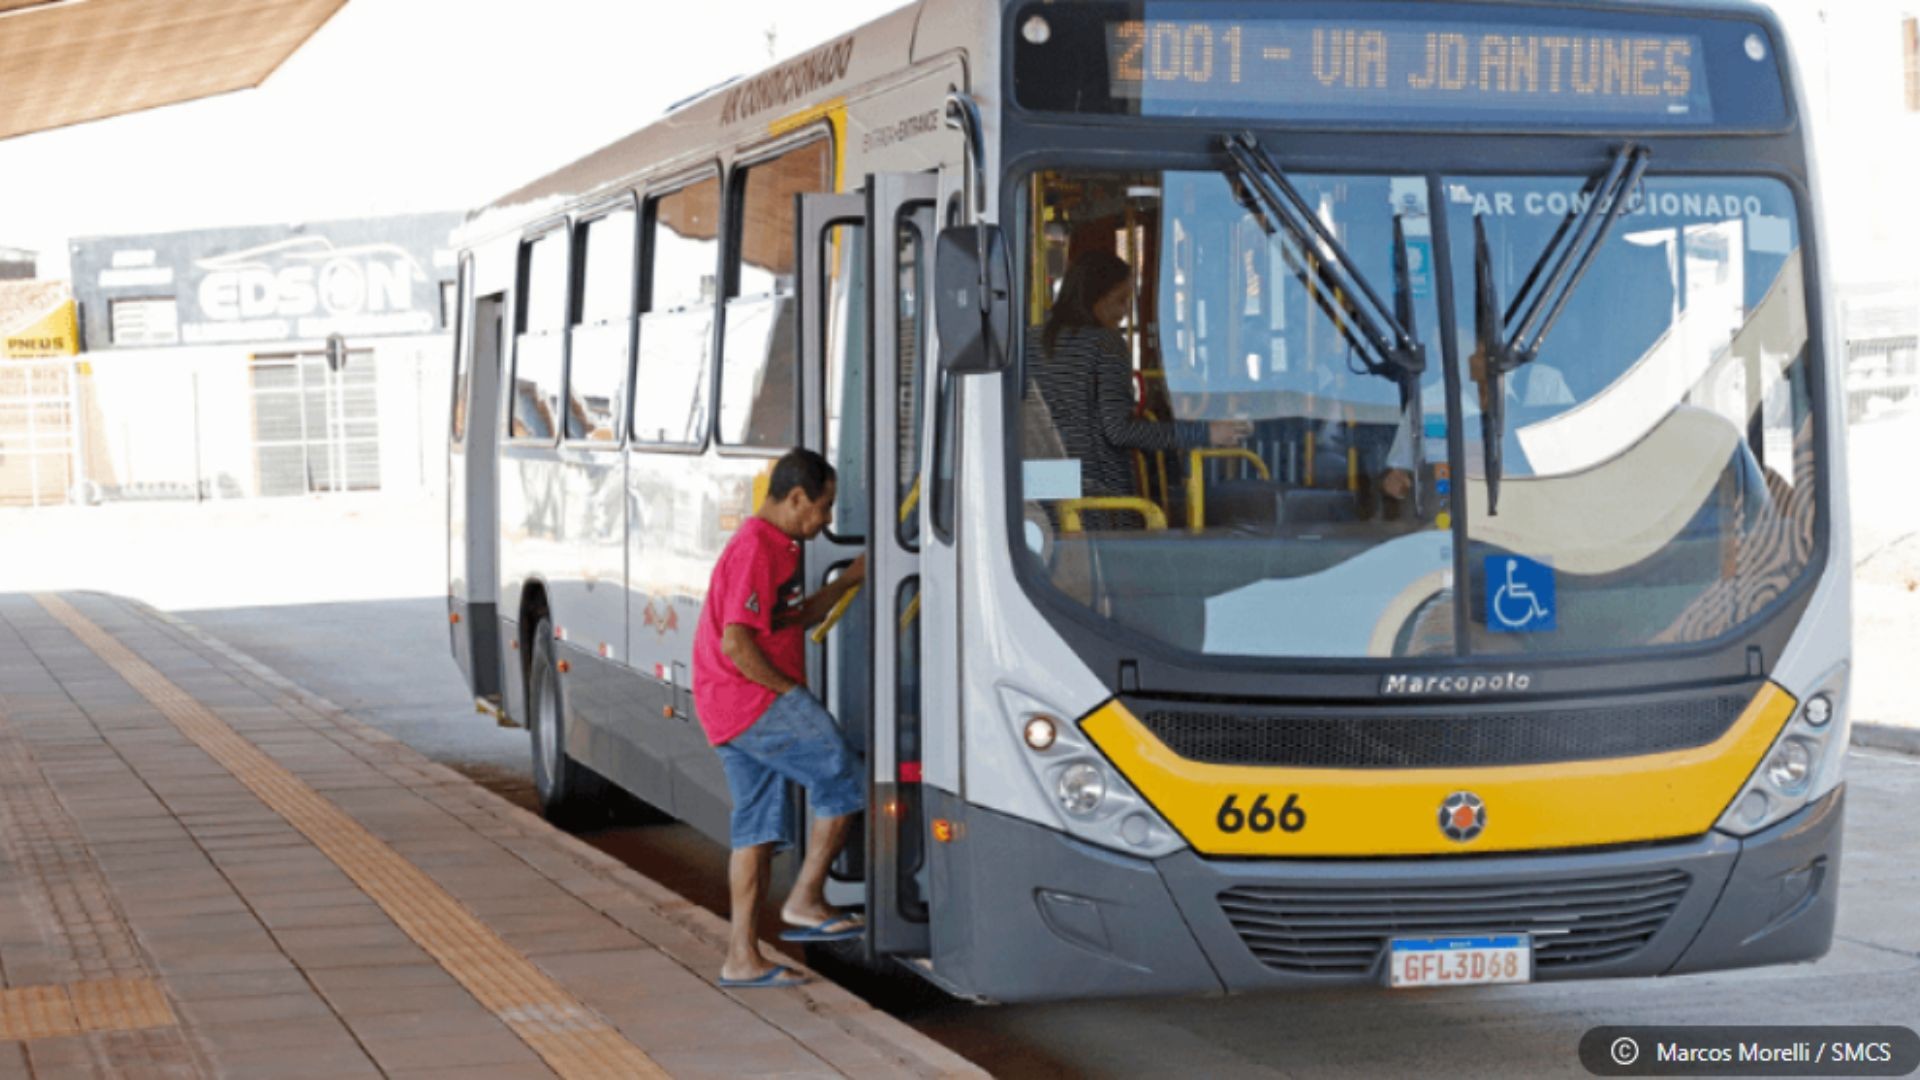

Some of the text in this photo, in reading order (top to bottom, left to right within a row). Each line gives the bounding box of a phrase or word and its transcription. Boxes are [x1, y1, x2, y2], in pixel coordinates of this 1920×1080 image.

[1115, 21, 1241, 82] 2001
[1312, 29, 1387, 88] VIA
[1472, 191, 1762, 217] AR CONDCIONADO
[199, 256, 412, 321] EDSON
[8, 337, 64, 350] PNEUS
[1385, 672, 1531, 694] Marcopolo
[1216, 793, 1307, 834] 666
[1404, 951, 1519, 981] GFL3D68
